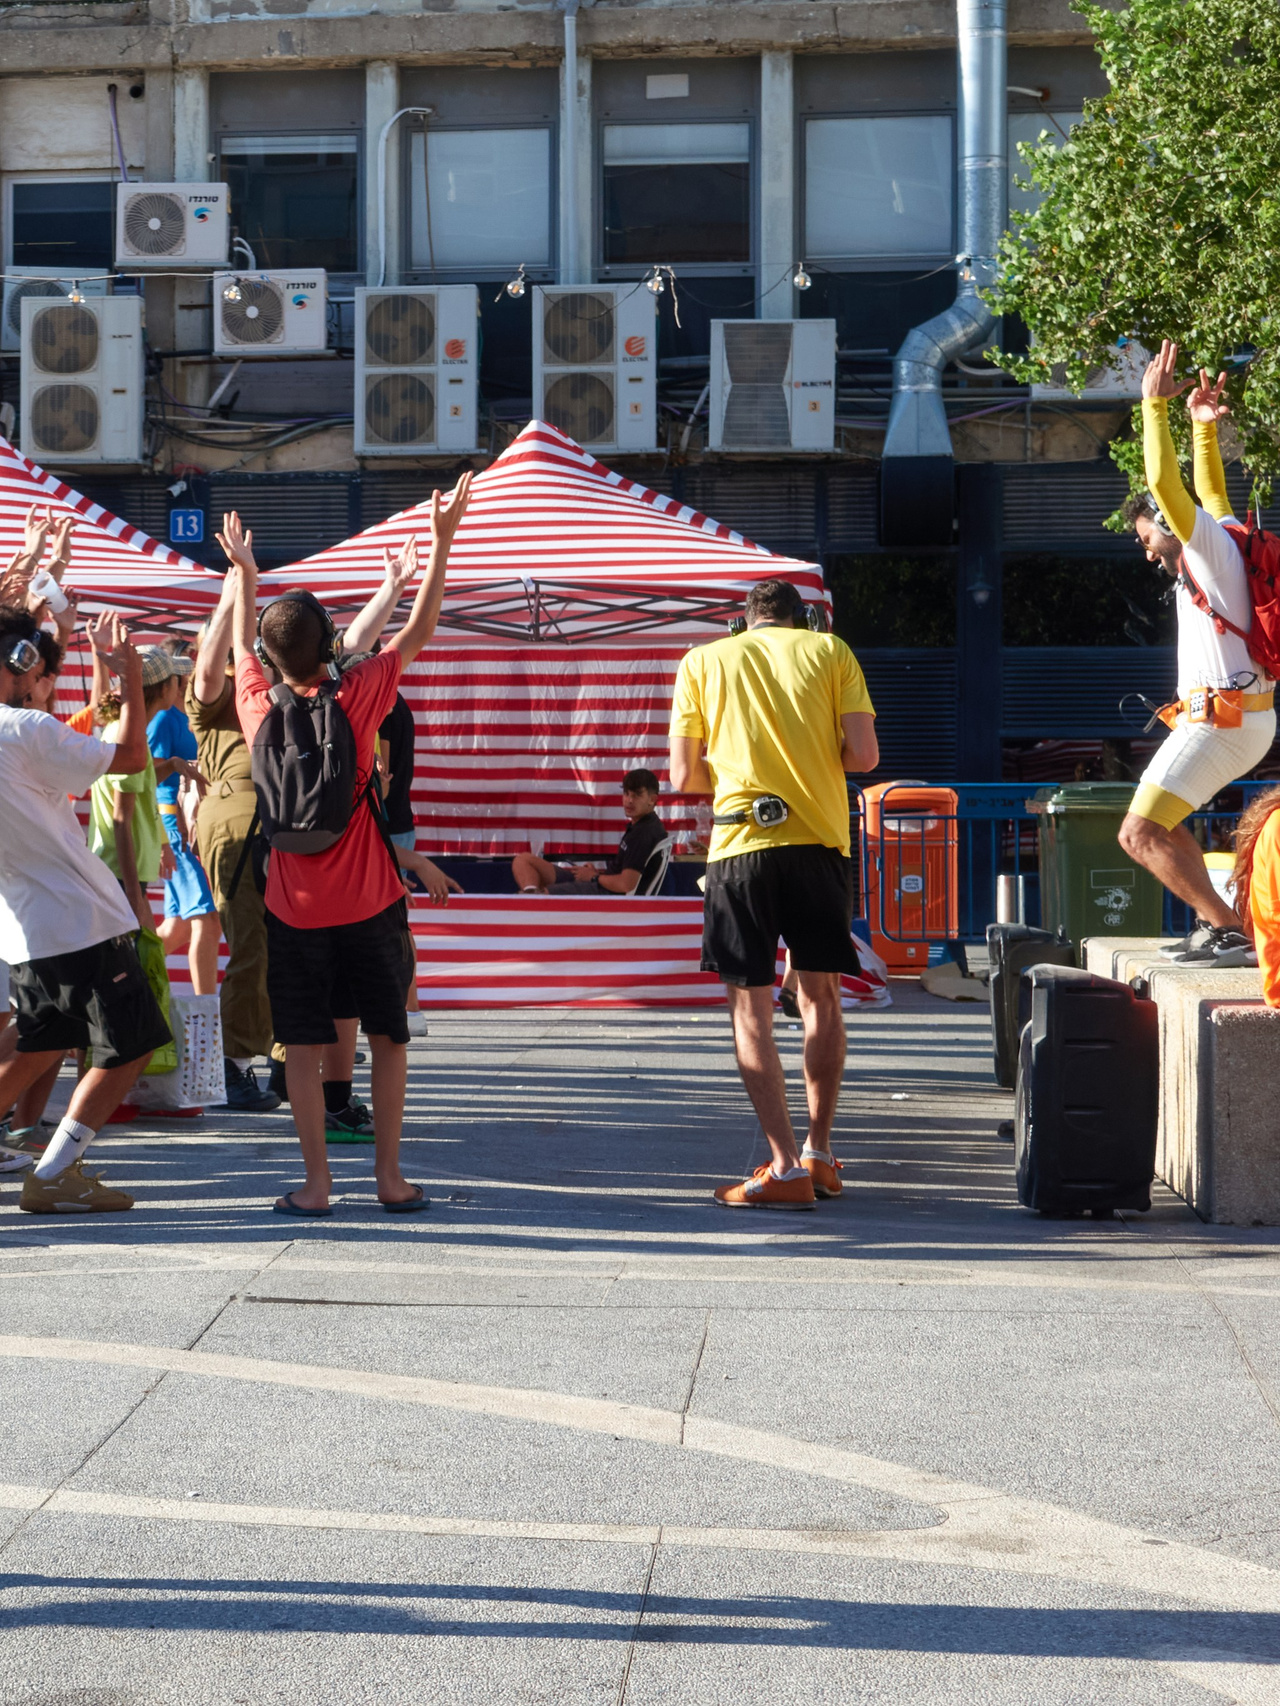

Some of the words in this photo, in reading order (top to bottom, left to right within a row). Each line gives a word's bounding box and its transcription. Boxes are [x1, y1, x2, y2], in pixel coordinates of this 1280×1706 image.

[452, 406, 459, 416] 2
[811, 402, 817, 411] 3
[175, 515, 199, 537] 13
